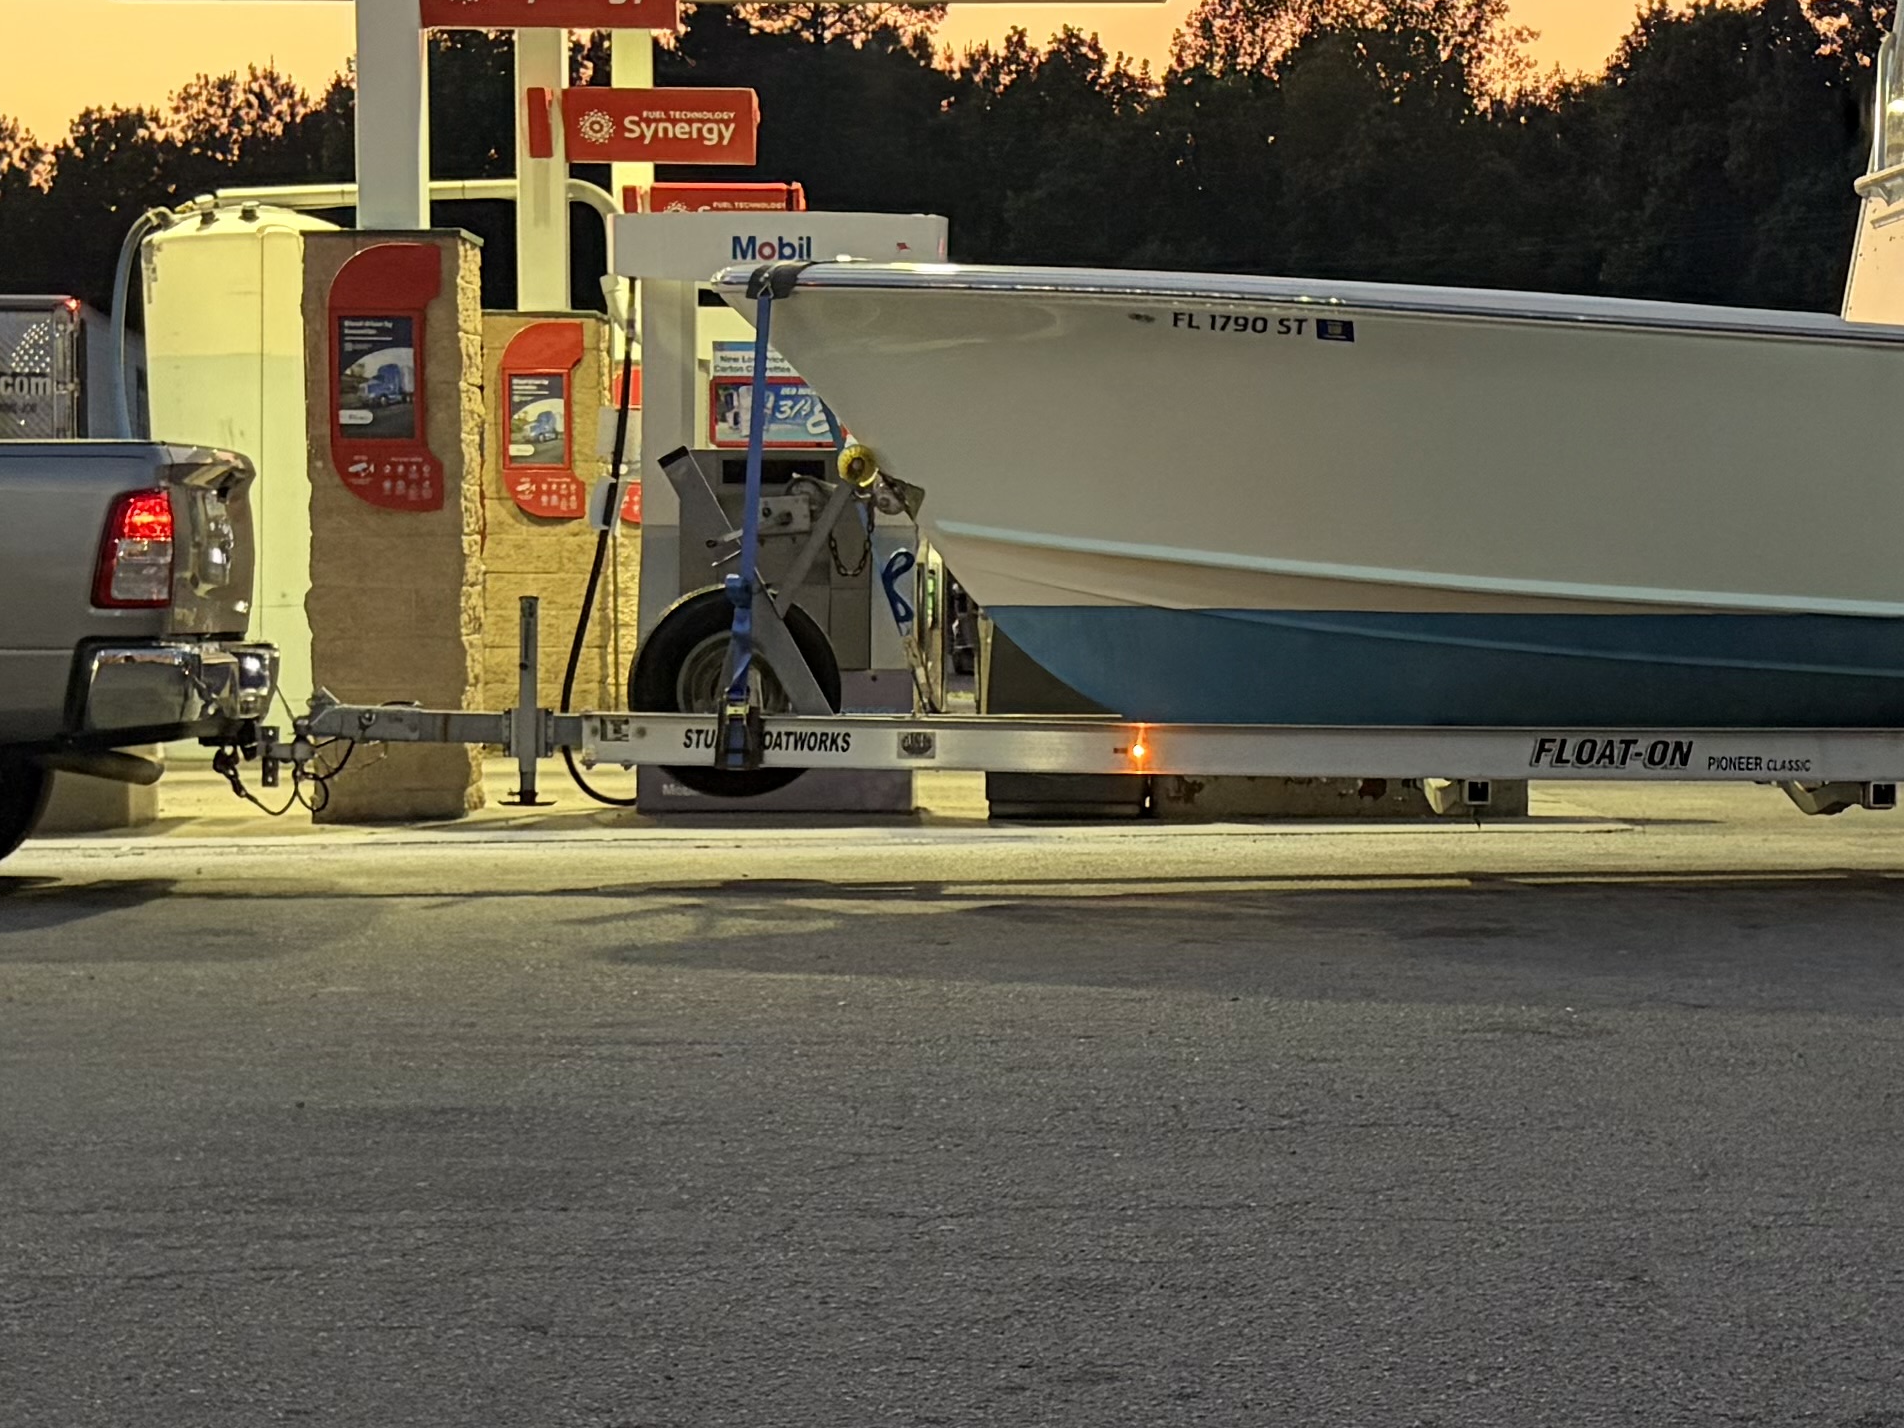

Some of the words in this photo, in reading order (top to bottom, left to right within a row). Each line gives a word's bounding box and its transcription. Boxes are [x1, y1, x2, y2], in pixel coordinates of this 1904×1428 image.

[643, 110, 665, 119] FUEL
[669, 111, 736, 120] TECHNOLOGY
[623, 116, 736, 146] Synergy
[731, 235, 812, 261] Mobil
[1172, 312, 1200, 330] FL
[1209, 314, 1269, 334] 1790
[1277, 318, 1308, 335] ST
[683, 728, 718, 750] STU
[762, 731, 852, 753] OATWORKS
[1531, 738, 1694, 768] FLOAT-ON
[1707, 756, 1763, 772] PIONEER
[1766, 758, 1812, 772] CLASSIC
